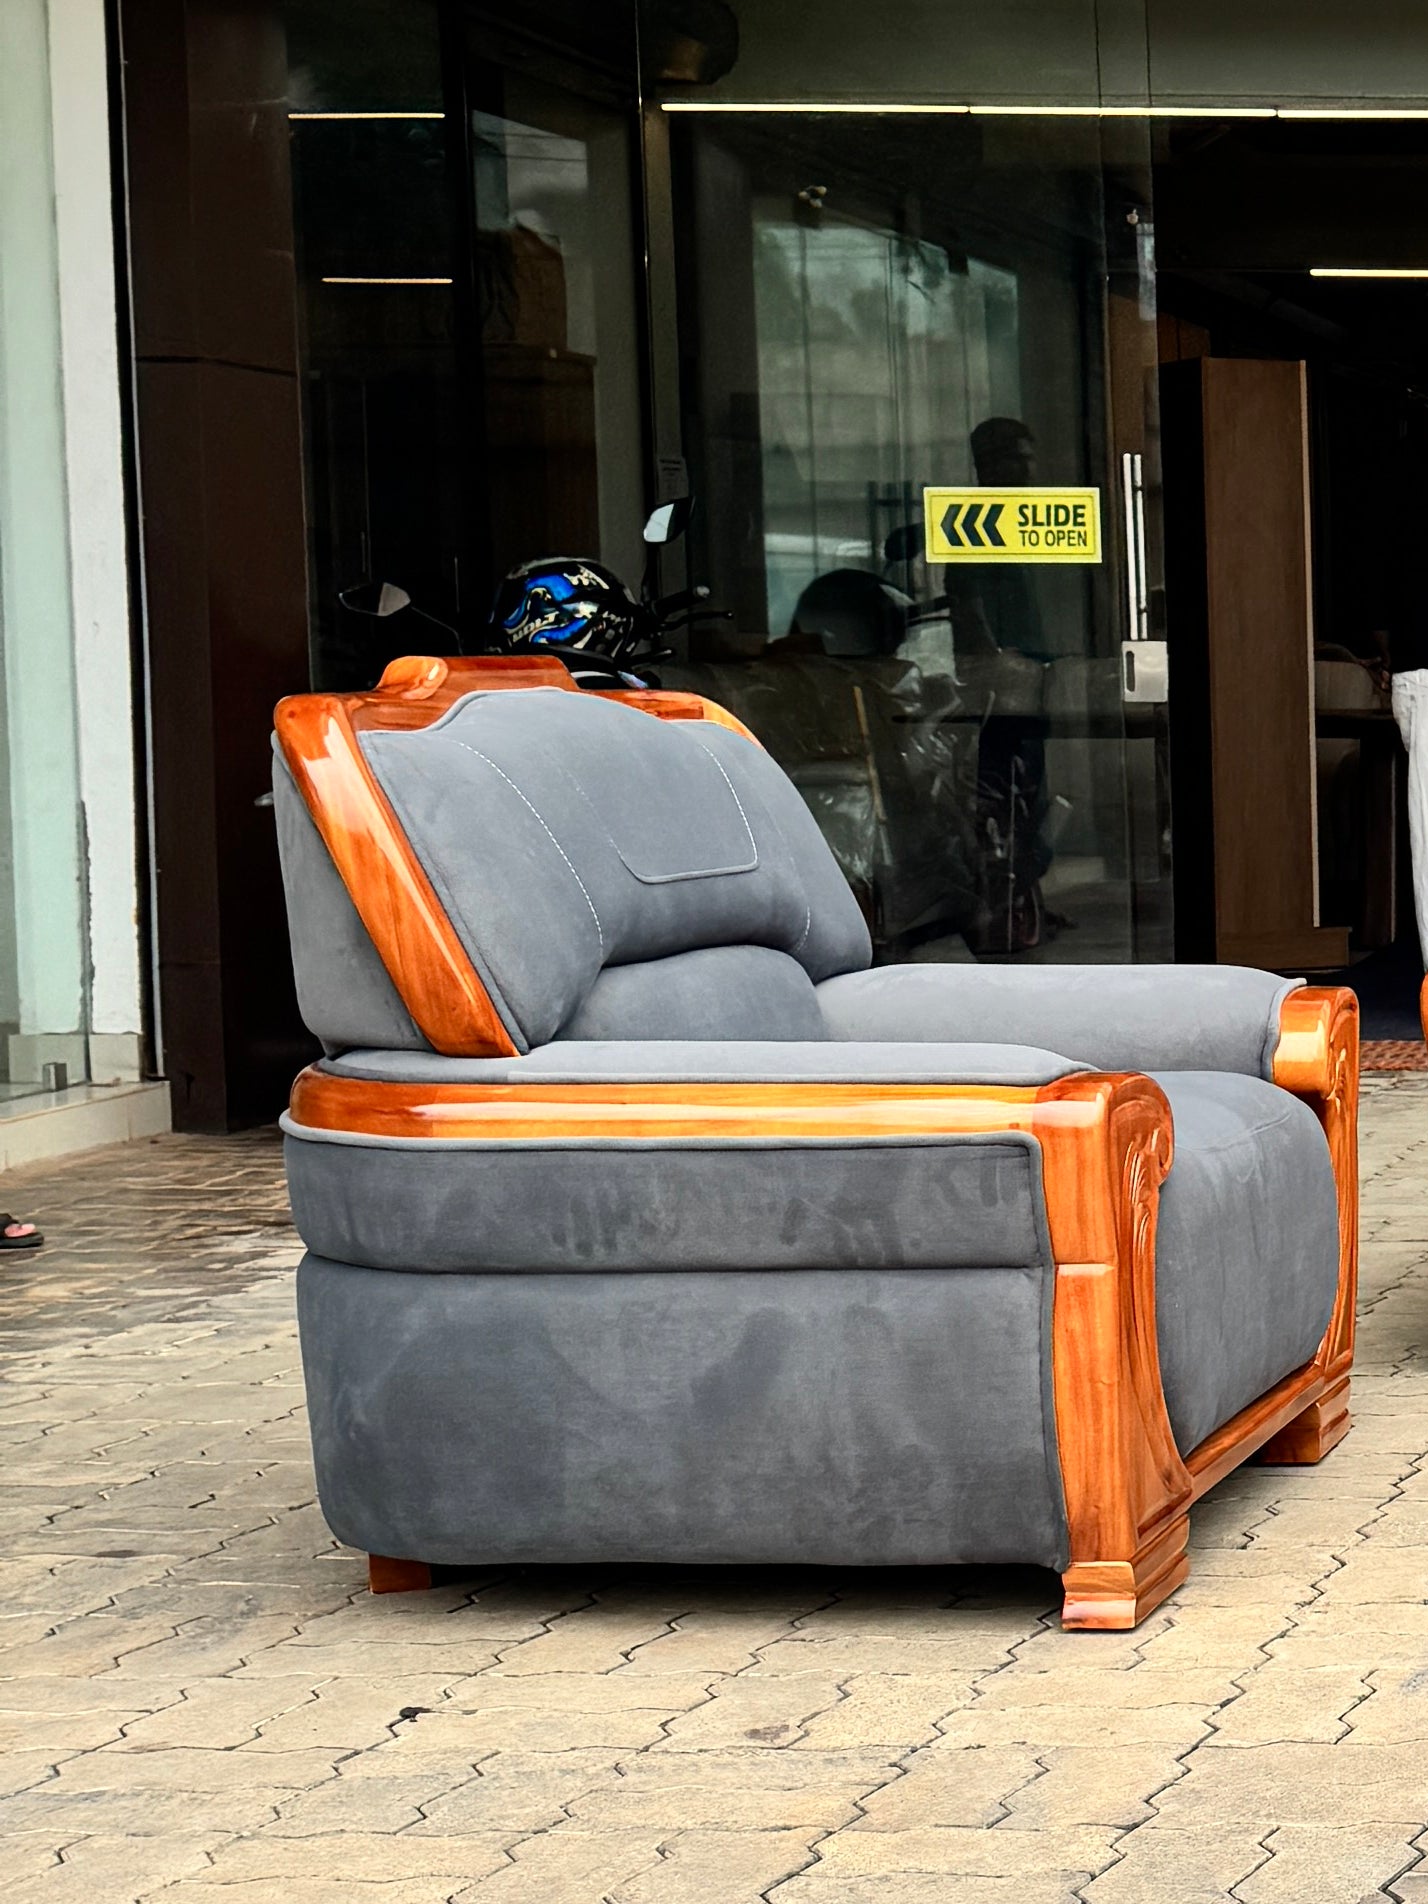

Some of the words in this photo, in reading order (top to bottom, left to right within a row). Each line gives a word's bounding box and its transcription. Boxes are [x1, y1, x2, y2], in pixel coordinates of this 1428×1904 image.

[1017, 503, 1087, 528] SLIDE
[1018, 529, 1040, 548] TO
[1044, 529, 1088, 547] OPEN
